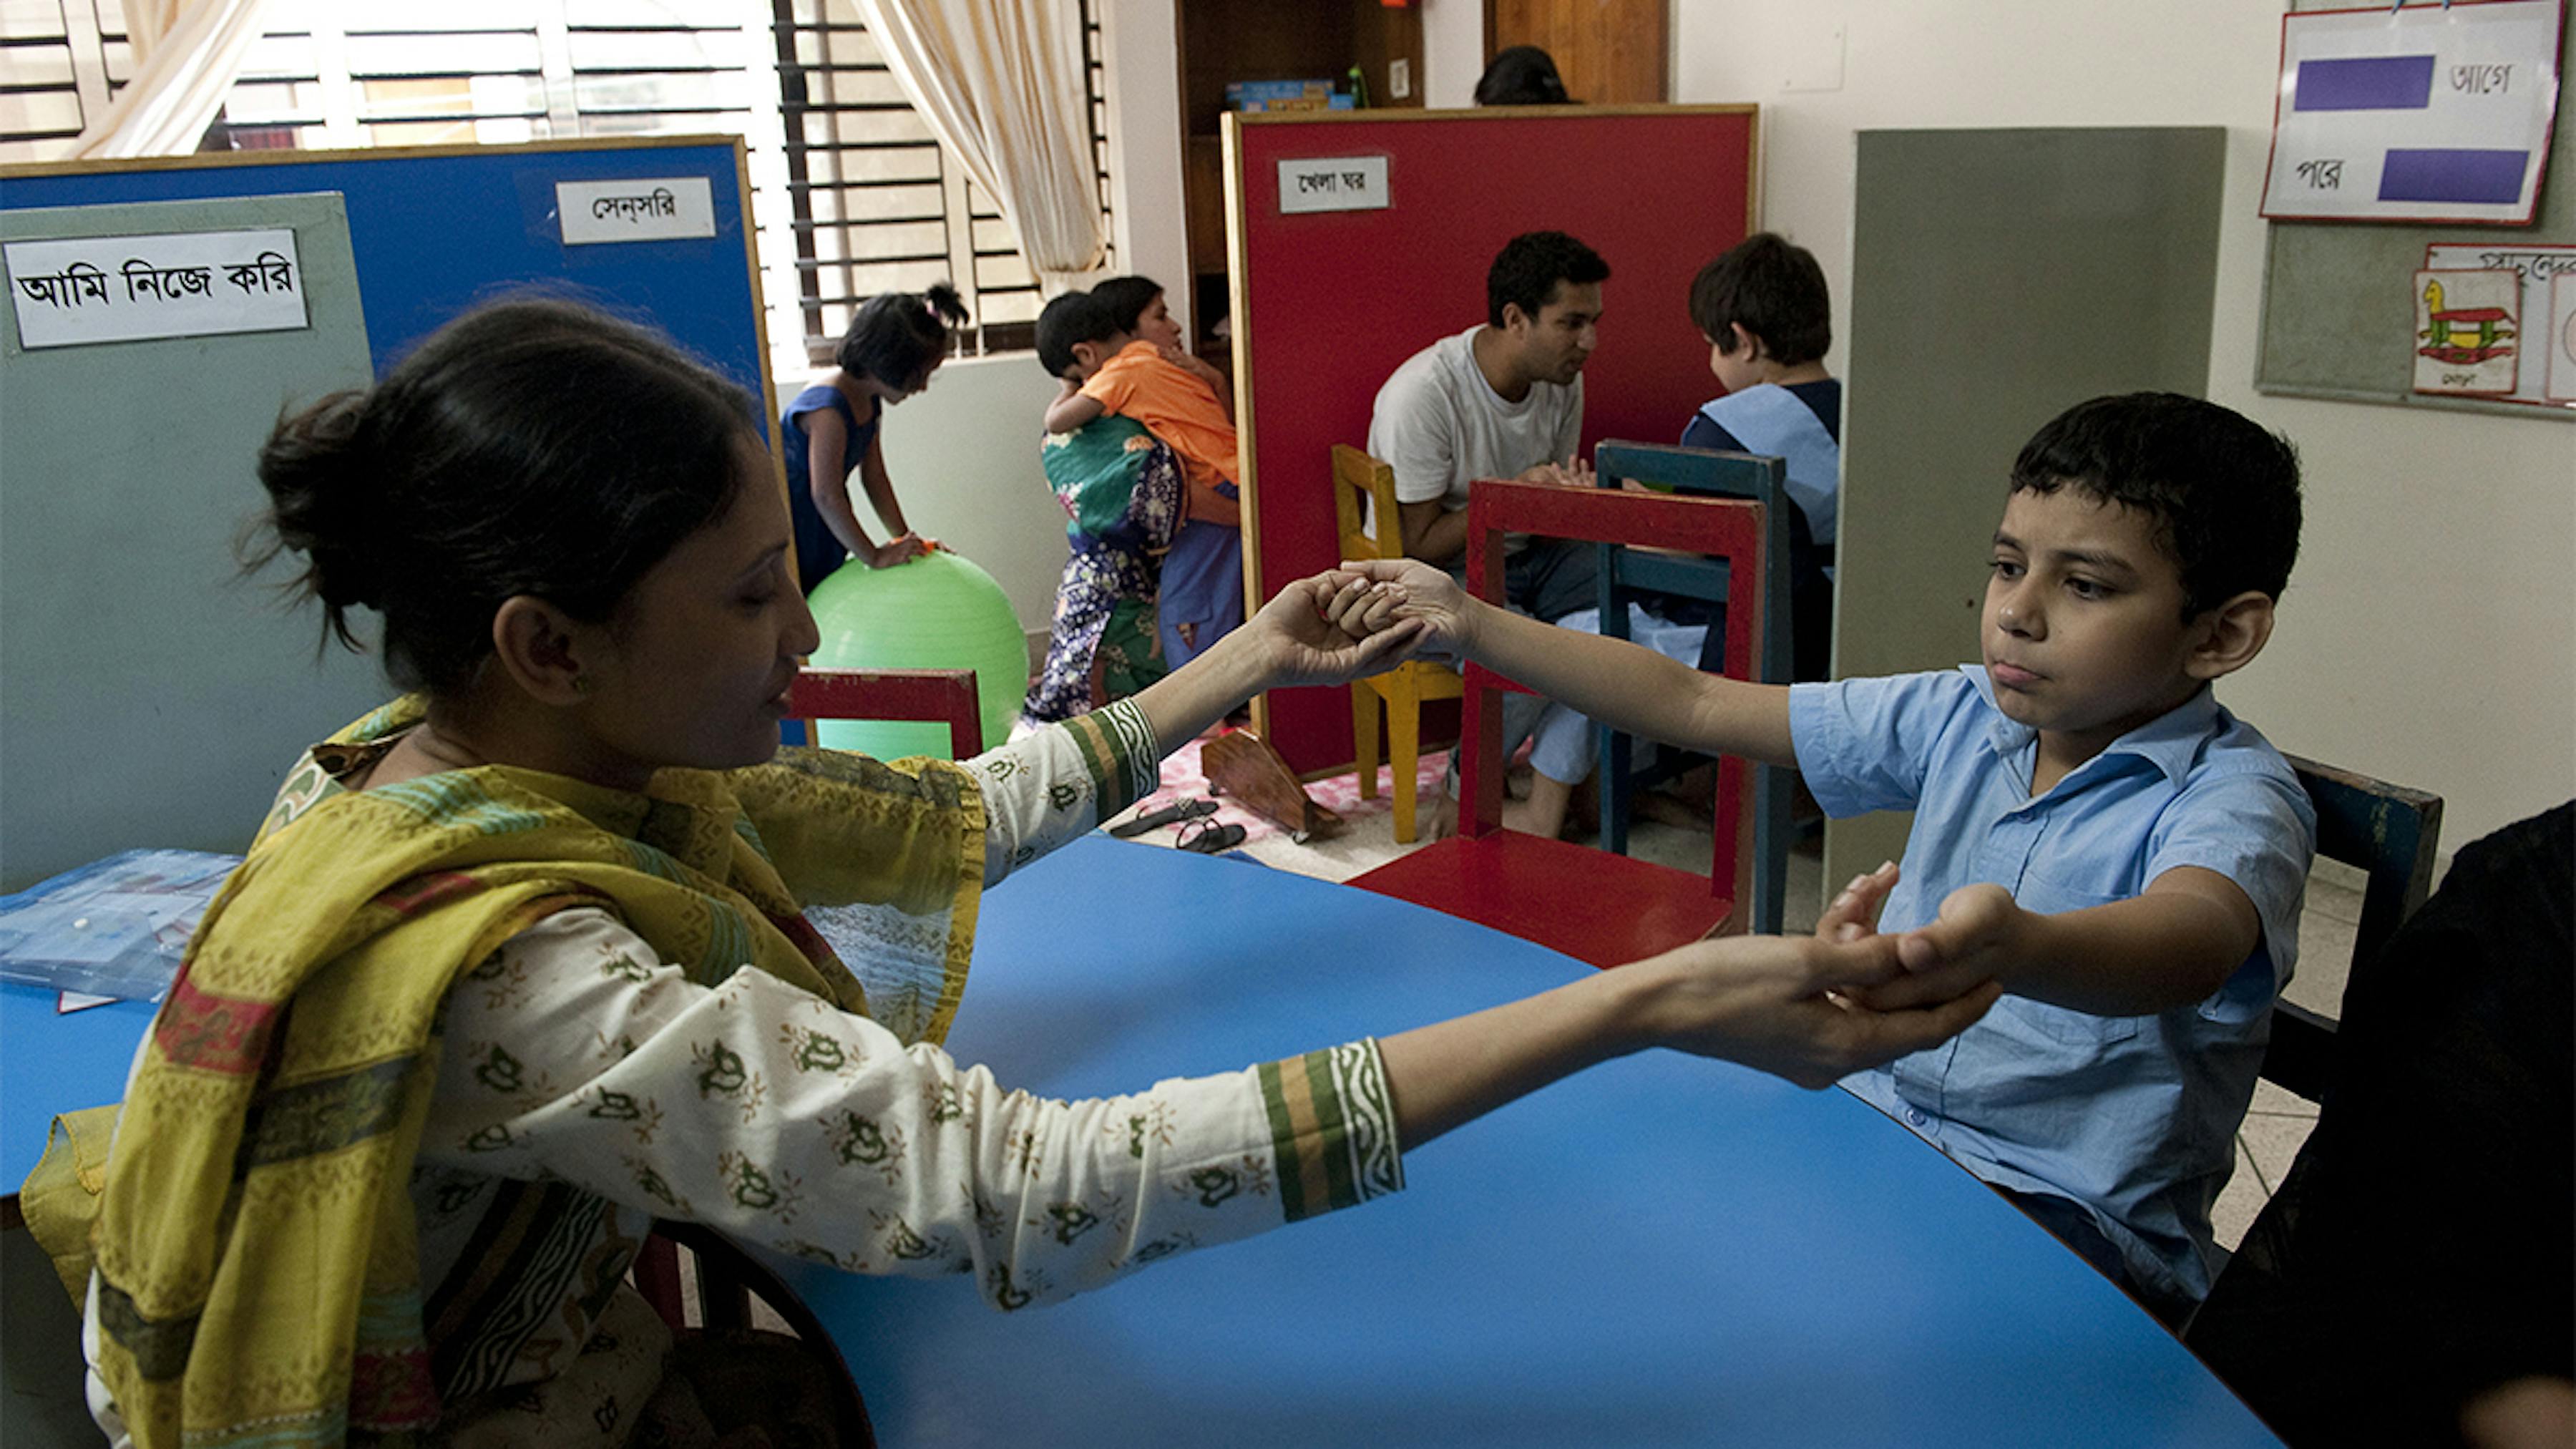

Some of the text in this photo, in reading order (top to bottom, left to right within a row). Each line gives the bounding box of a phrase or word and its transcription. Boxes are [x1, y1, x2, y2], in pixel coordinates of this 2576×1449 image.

[2449, 63, 2515, 94] আগে
[1297, 171, 1366, 193] খেলা ঘর
[2295, 159, 2346, 190] পরে
[16, 250, 293, 308] আমি নিজে করি
